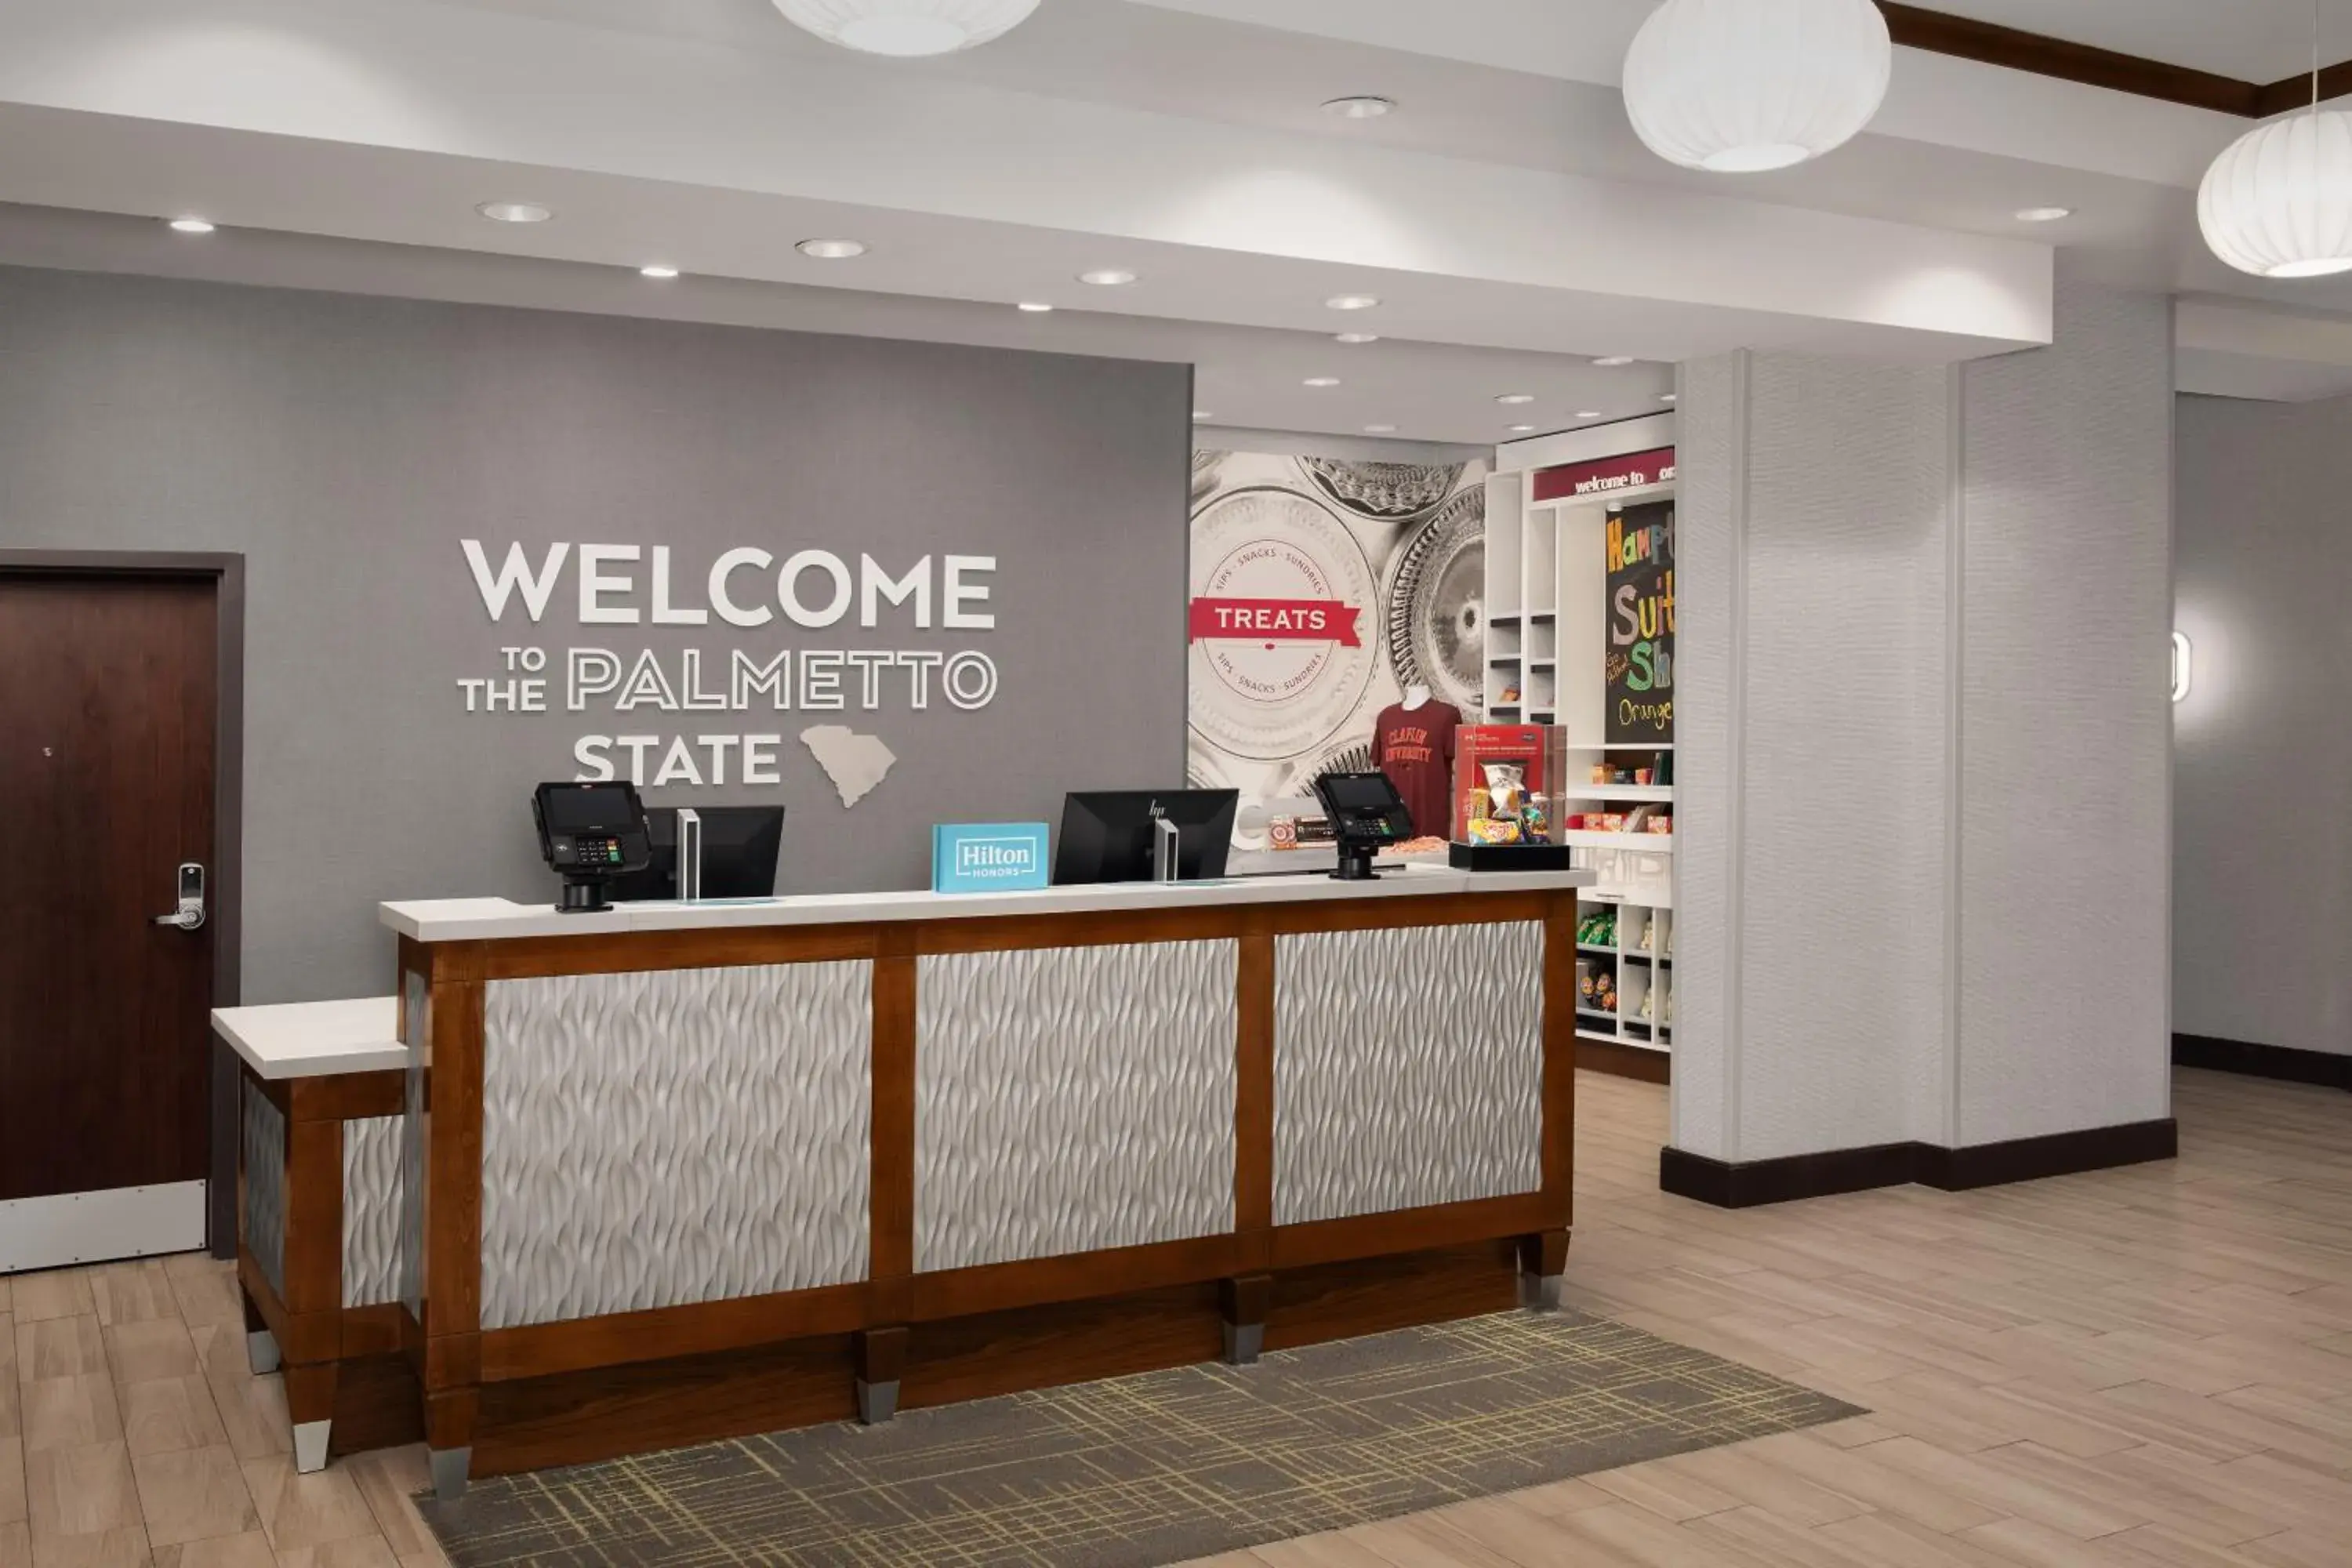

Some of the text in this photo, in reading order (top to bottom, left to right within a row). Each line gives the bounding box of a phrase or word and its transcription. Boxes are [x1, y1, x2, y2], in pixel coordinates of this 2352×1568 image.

[1574, 475, 1629, 494] welcome
[1631, 471, 1645, 486] to
[460, 539, 996, 629] WELCOME
[1238, 548, 1277, 567] SNACKS
[1286, 553, 1325, 595] SUNDRIES
[1214, 607, 1327, 630] TREATS
[501, 647, 546, 672] TO
[1237, 675, 1276, 694] SNACKS
[1283, 652, 1322, 691] SUNDRIES
[457, 647, 998, 712] THE PALMETTO
[1619, 699, 1673, 730] Orange
[574, 734, 781, 787] STATE
[964, 844, 1029, 866] Hilton
[972, 867, 1019, 879] HONORS
